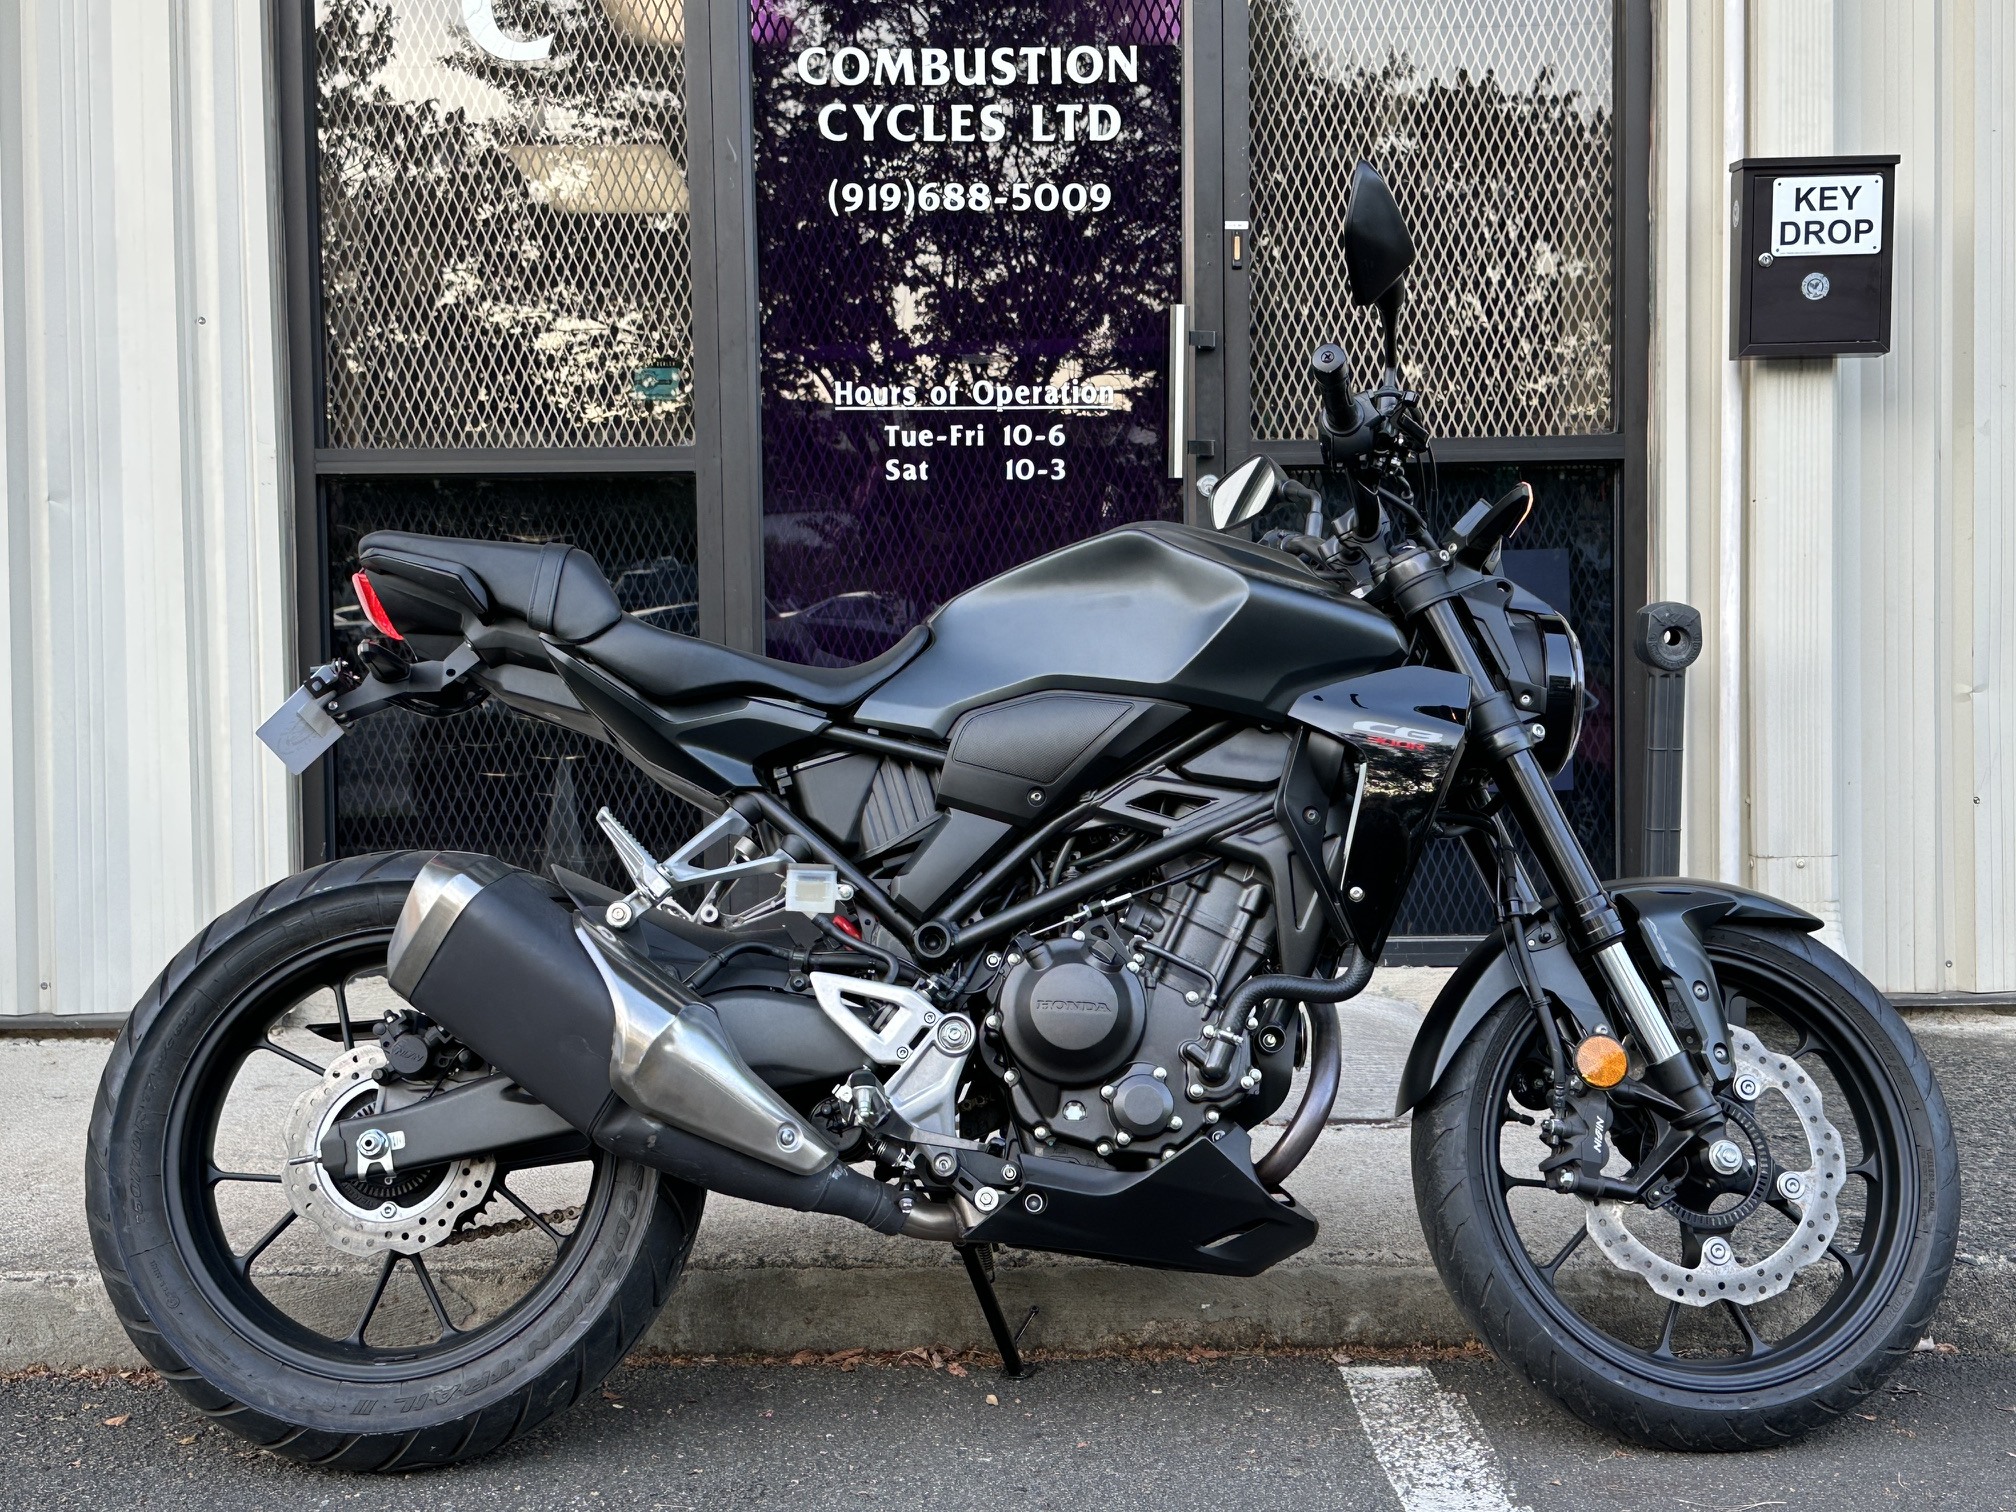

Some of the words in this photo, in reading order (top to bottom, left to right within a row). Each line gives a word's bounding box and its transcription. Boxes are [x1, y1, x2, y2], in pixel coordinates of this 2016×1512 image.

[797, 45, 1138, 86] COMBUSTION
[818, 102, 1006, 143] CYCLES
[1032, 102, 1122, 143] LTD
[828, 178, 1112, 217] (919)688-5009
[1795, 185, 1862, 212] KEY
[1780, 219, 1874, 245] DROP
[834, 380, 916, 406] Hours
[934, 379, 959, 406] of
[973, 378, 1115, 412] Operation
[884, 424, 985, 447] Tue-Fri
[1003, 424, 1067, 447] 10-6
[885, 459, 929, 481] Sat
[1005, 459, 1067, 481] 10-3
[1353, 720, 1444, 743] CB
[1366, 735, 1426, 752] 300R
[1035, 999, 1112, 1013] HONDA
[393, 1358, 516, 1413] TRAIL
